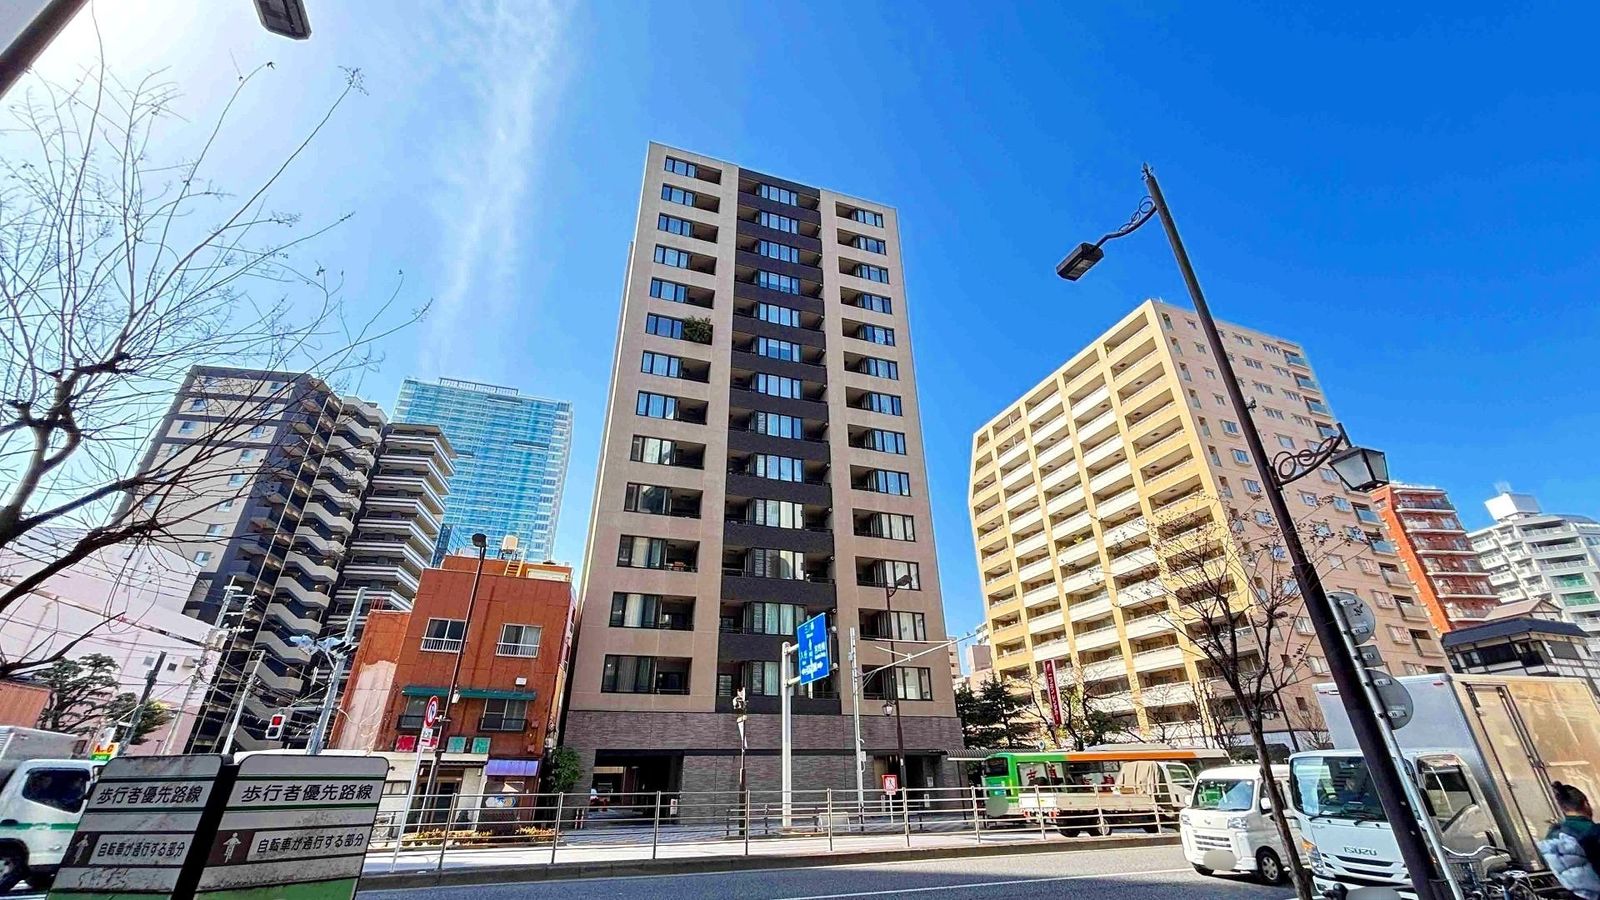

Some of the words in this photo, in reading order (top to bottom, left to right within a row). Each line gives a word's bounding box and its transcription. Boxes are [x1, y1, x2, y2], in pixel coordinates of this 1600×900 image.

[96, 785, 203, 805] 歩行者優先路線
[241, 783, 374, 803] 歩行者優先路線
[97, 841, 186, 858] 自転車が通行する部分
[256, 833, 365, 854] 自転車が通行する部分
[1343, 846, 1378, 857] ISUZU
